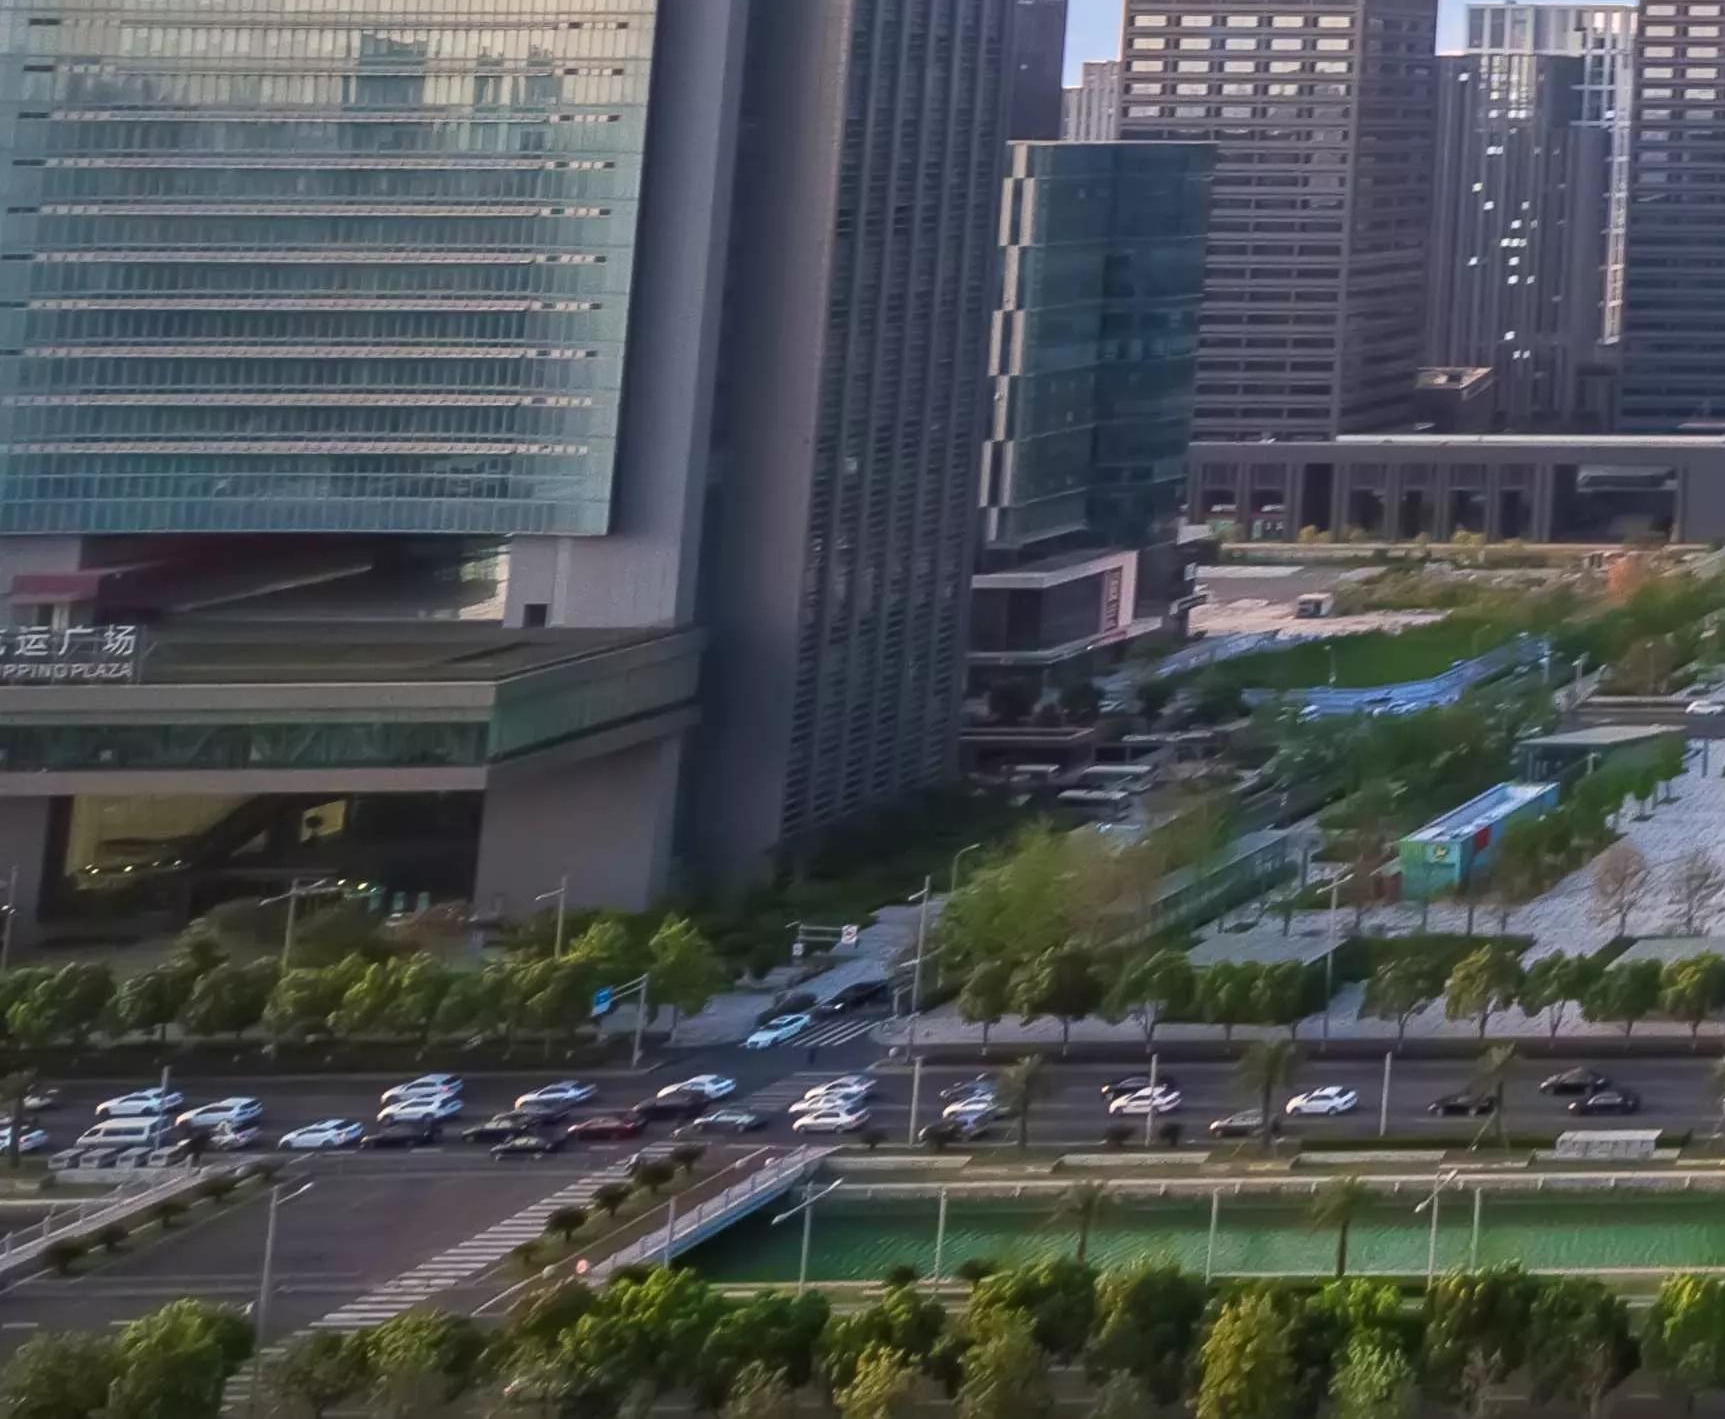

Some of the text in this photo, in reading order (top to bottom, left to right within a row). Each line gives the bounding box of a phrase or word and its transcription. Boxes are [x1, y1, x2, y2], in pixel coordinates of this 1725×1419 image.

[0, 624, 136, 656] 运广场
[0, 663, 133, 678] PPING PLAZA
